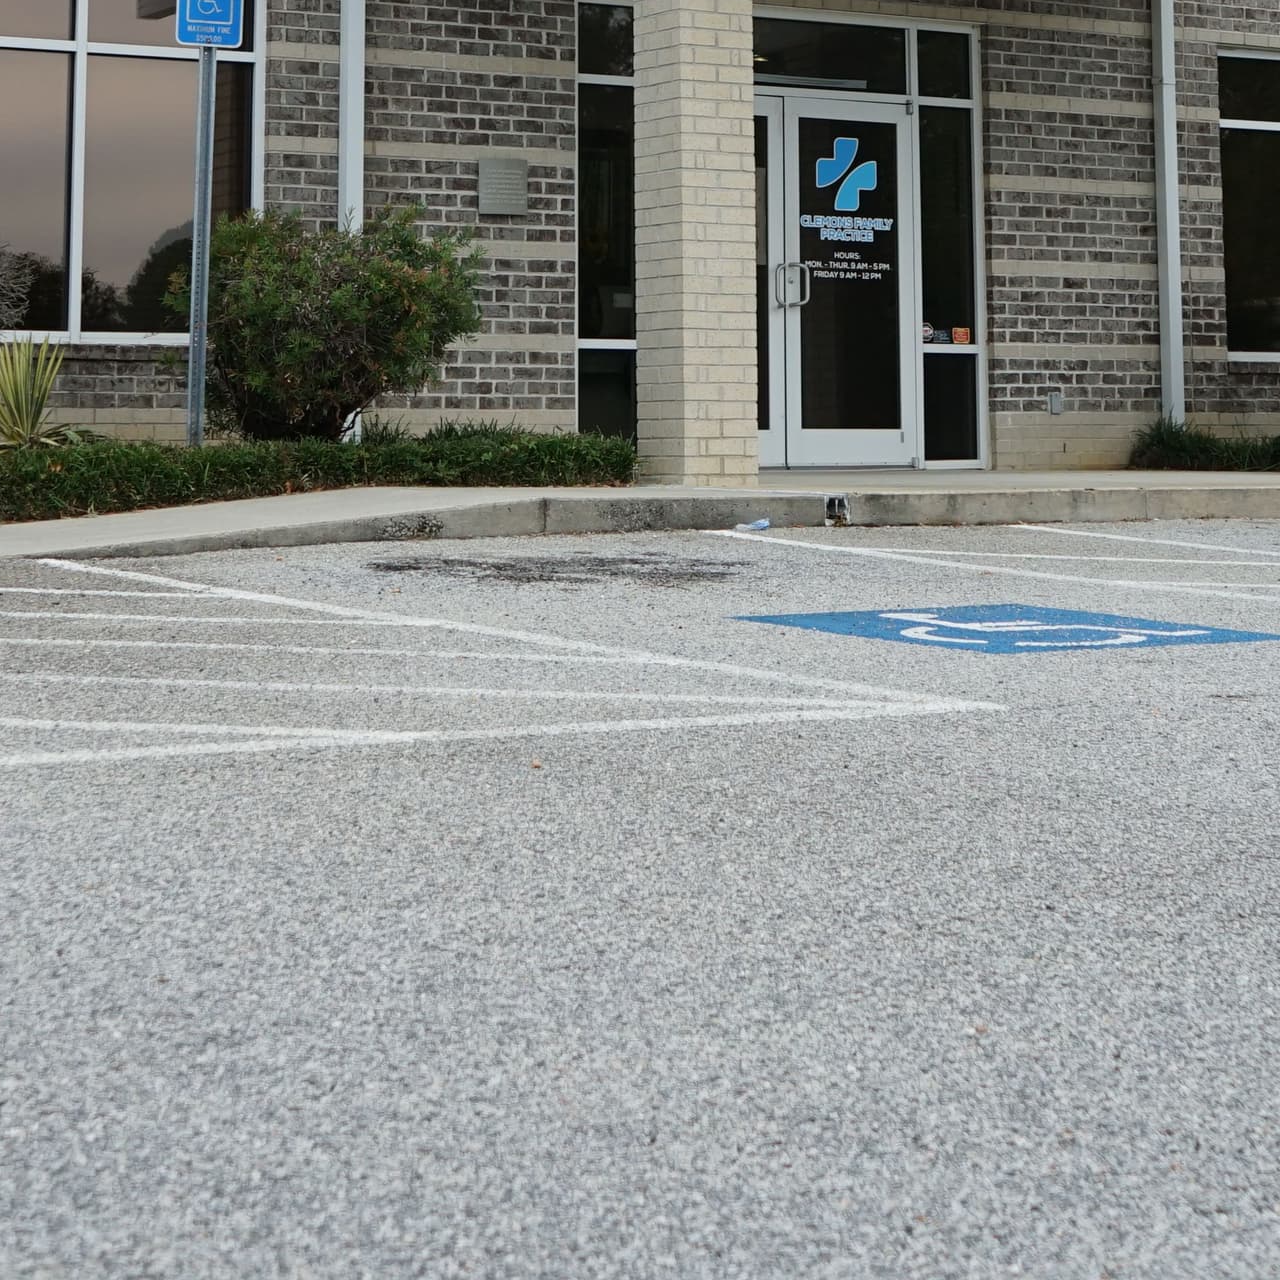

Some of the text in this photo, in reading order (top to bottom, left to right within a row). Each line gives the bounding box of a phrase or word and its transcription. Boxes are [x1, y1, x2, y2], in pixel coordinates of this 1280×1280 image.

[187, 25, 232, 35] MAXIMUM FINE
[800, 215, 893, 230] CLEMONS FAMILY
[820, 228, 874, 242] PRACTICE
[834, 251, 861, 260] HOURS:
[805, 260, 824, 268] MON.
[850, 261, 856, 269] 9
[856, 262, 868, 270] AM
[813, 270, 839, 279] FRIDAY
[839, 271, 845, 279] 9
[845, 271, 857, 279] AM
